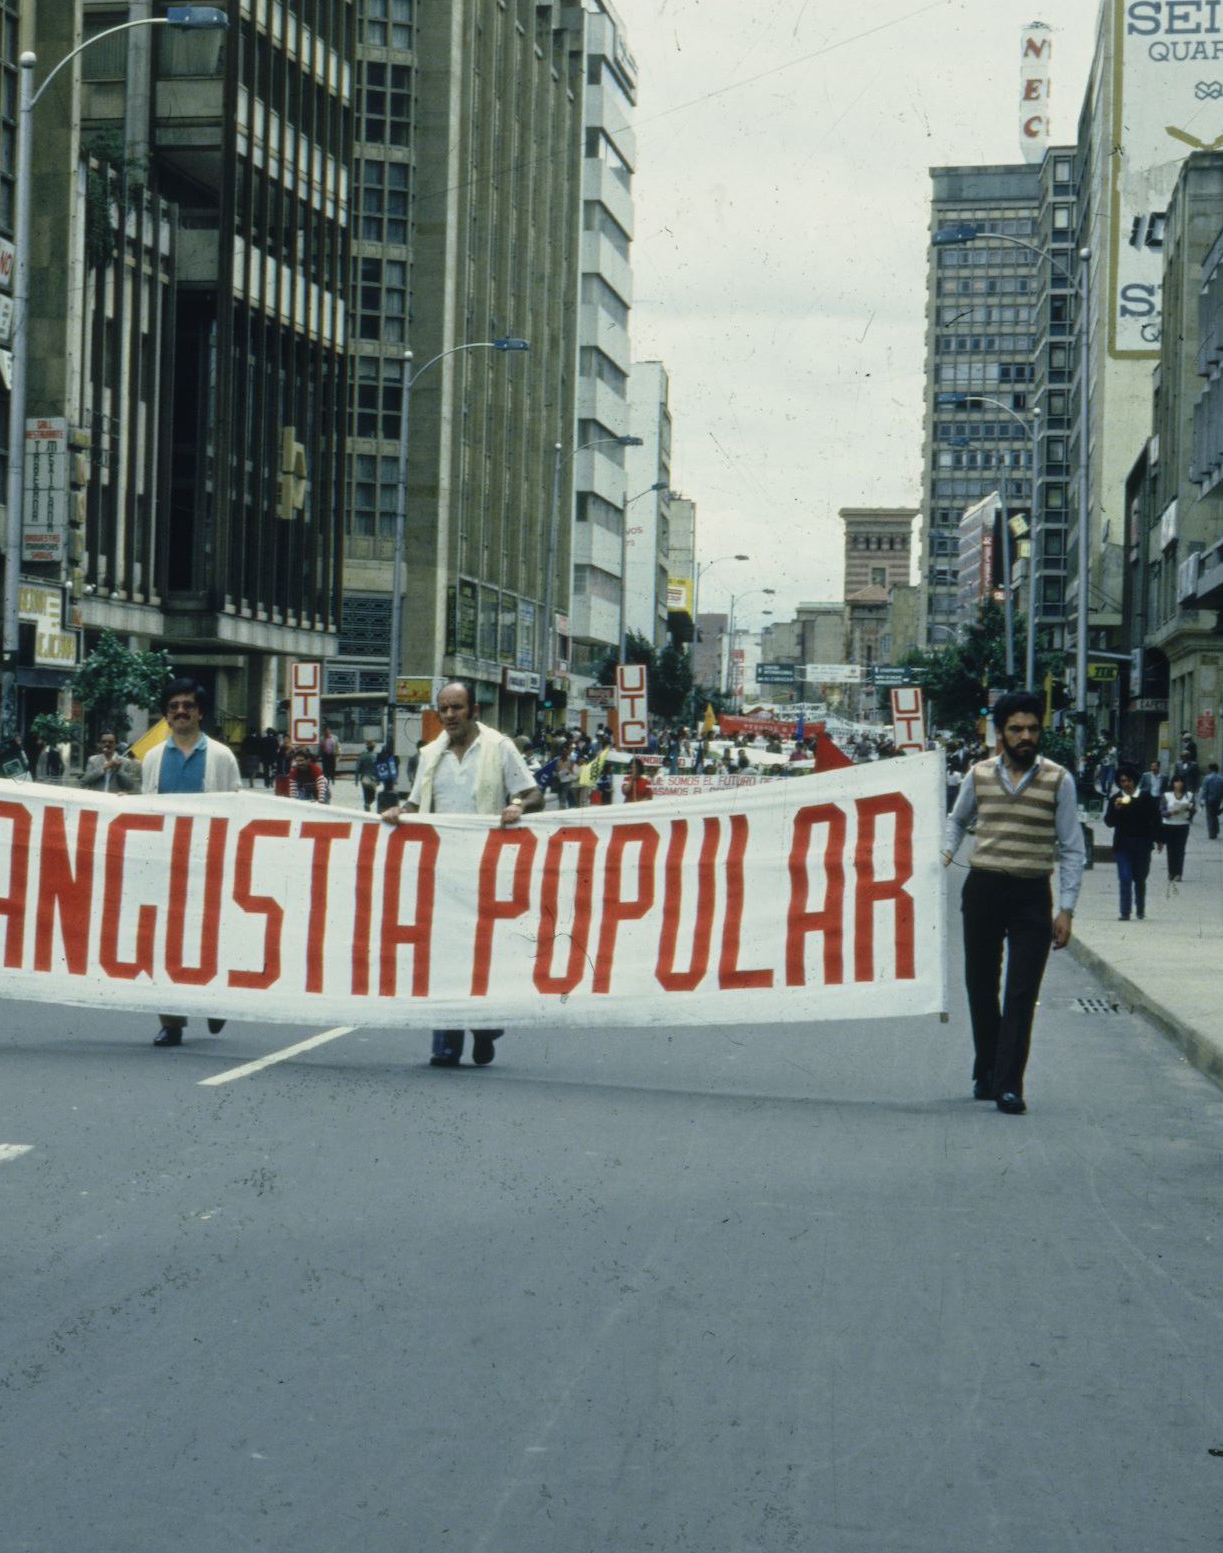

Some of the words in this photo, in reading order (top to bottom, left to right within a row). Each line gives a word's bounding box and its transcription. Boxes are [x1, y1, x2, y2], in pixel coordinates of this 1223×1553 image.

[1023, 36, 1048, 138] NEC
[1120, 283, 1162, 318] S
[294, 665, 318, 742] UTC
[620, 667, 646, 745] UTC
[470, 791, 916, 997] POPULAR
